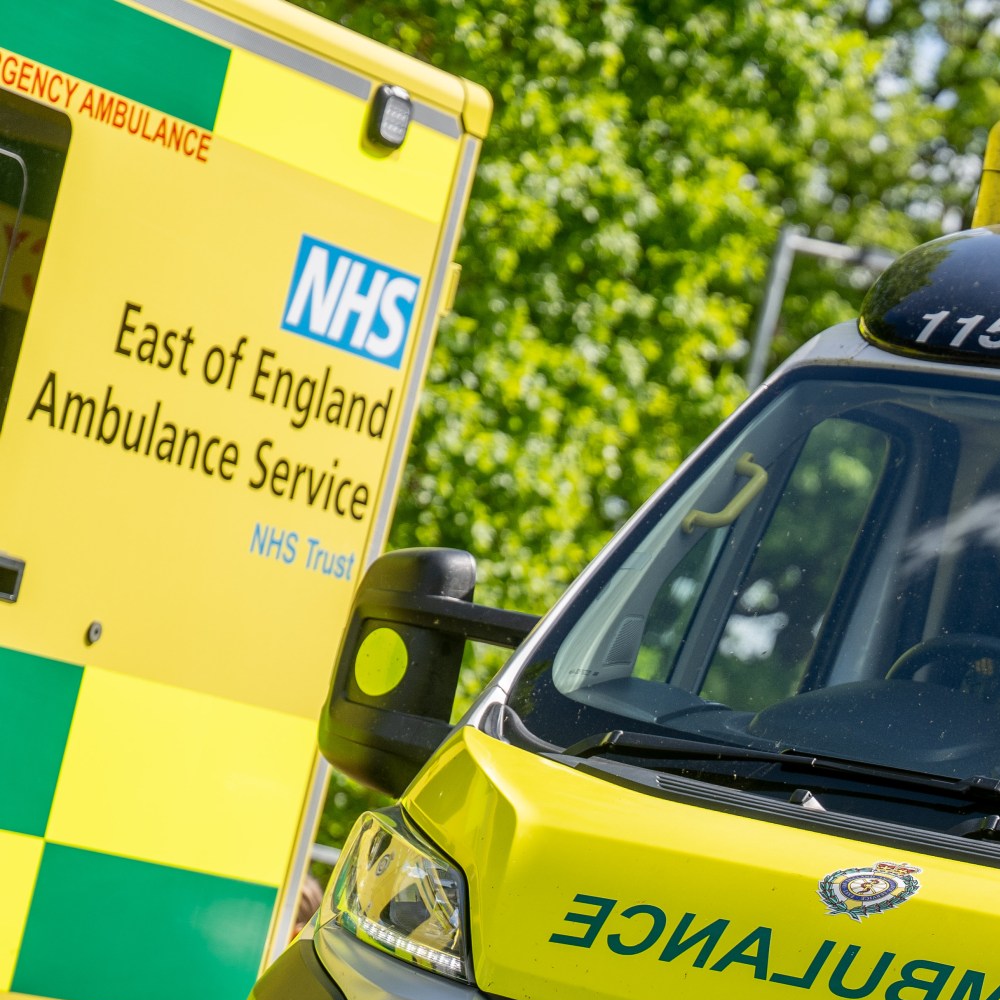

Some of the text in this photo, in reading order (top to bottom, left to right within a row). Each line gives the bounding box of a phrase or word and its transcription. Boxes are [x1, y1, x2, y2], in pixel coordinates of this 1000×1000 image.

[0, 54, 212, 163] GENCY AMBULANCE
[284, 244, 420, 359] NHS
[114, 301, 395, 440] East of England
[26, 370, 371, 522] Ambulance Service
[249, 522, 357, 581] NHS Trust
